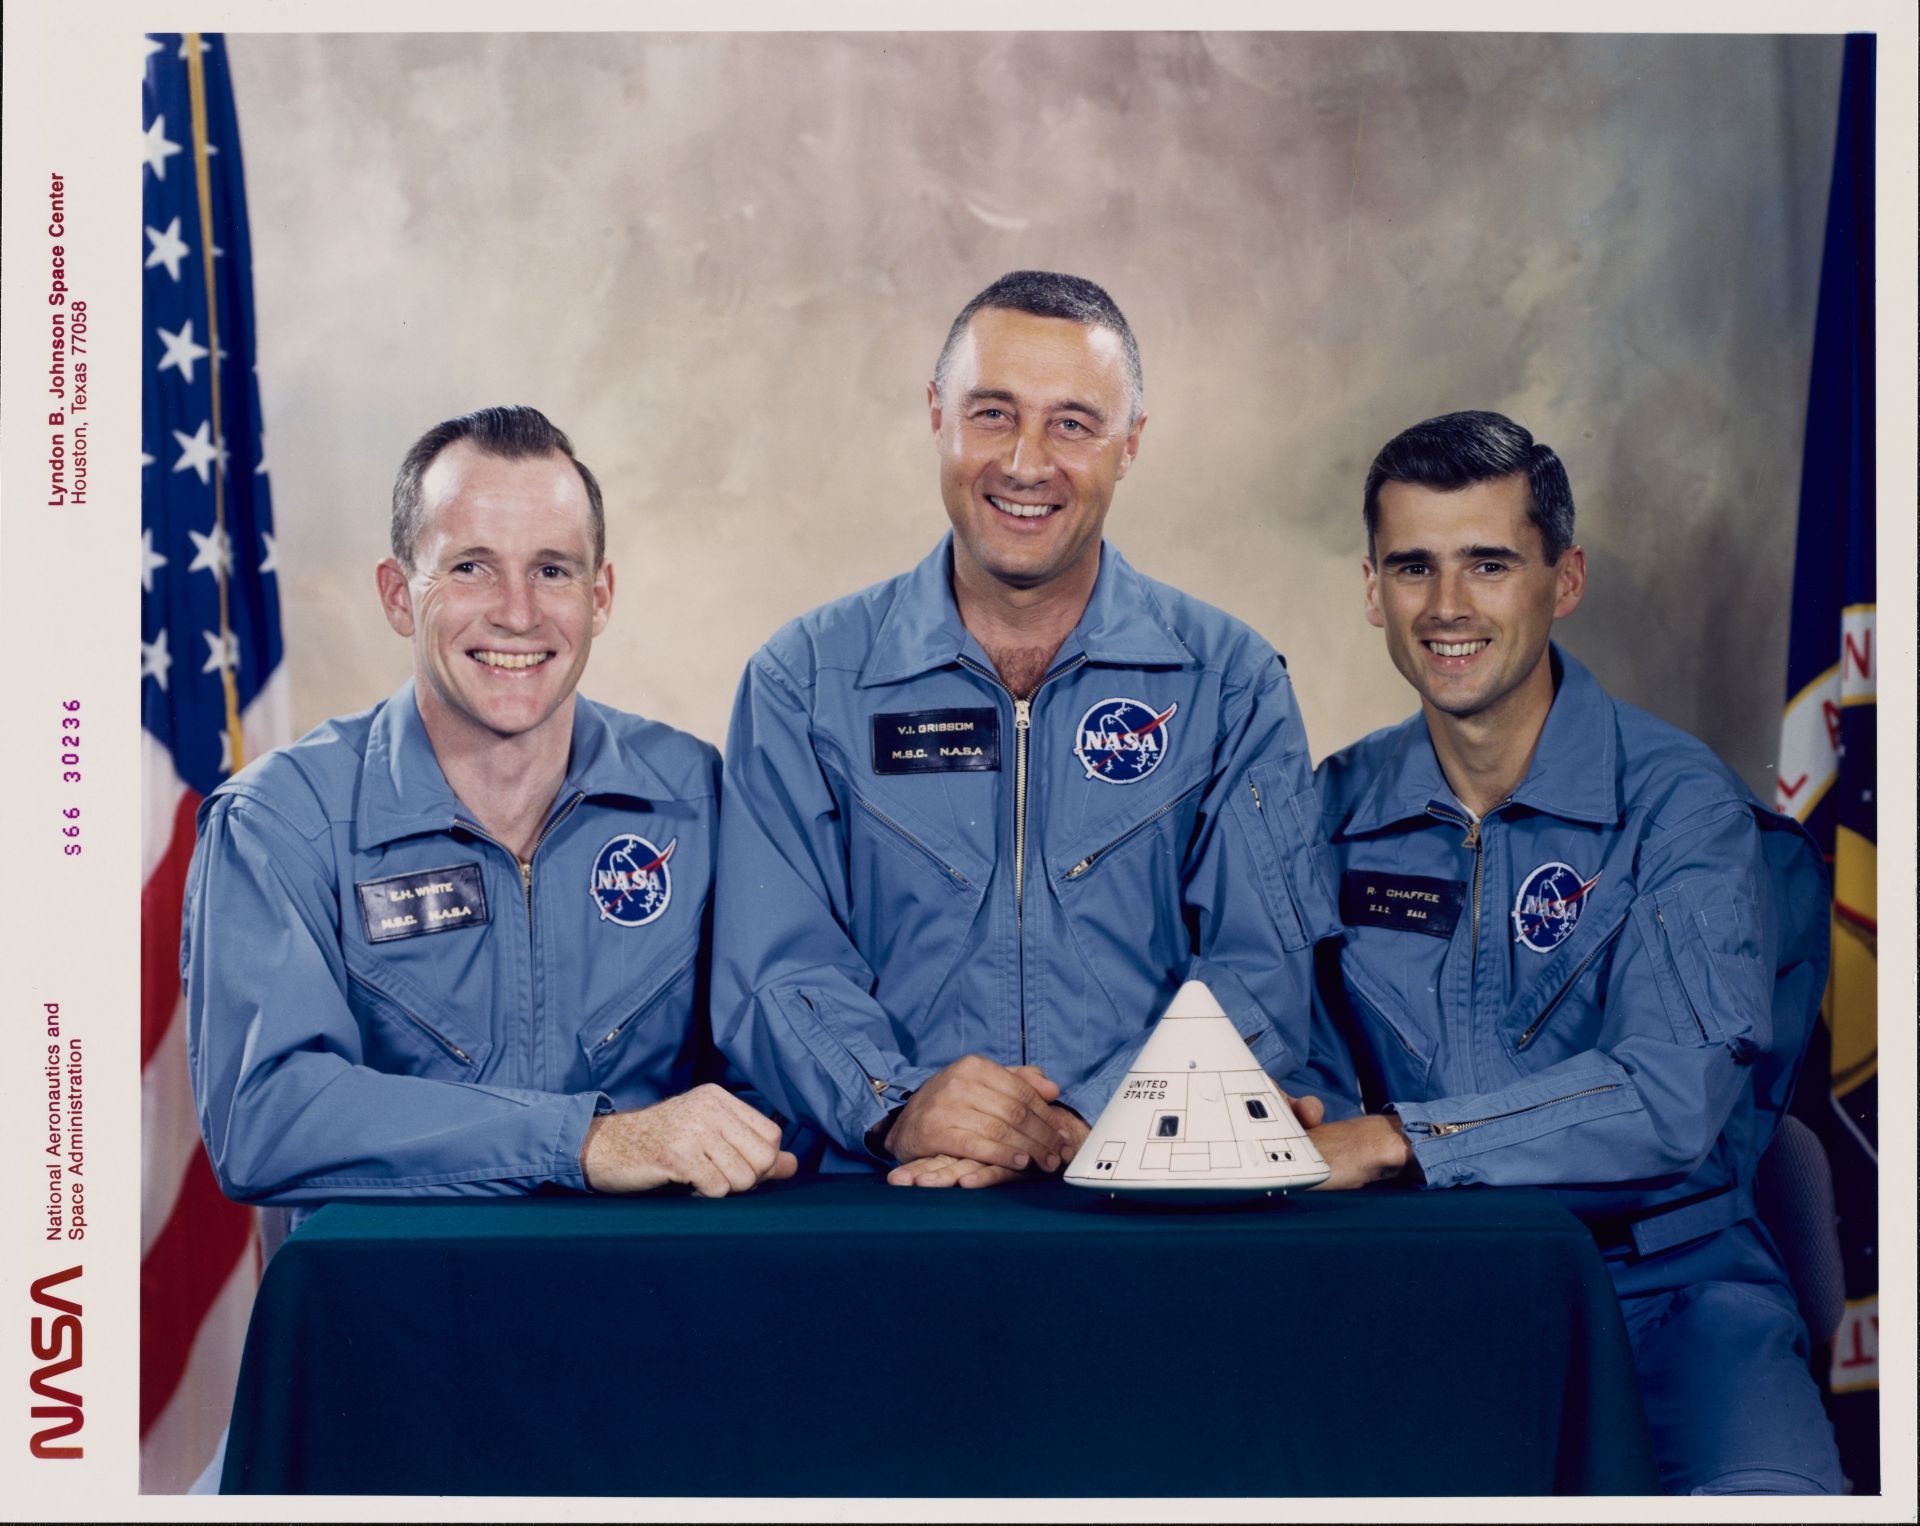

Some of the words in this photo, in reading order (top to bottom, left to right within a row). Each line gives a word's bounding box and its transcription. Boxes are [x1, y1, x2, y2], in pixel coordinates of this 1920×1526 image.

[917, 721, 975, 735] GRISSOM
[1084, 729, 1159, 752] NASA
[891, 748, 929, 760] M.S.C.
[597, 869, 663, 892] NASA
[415, 881, 454, 897] WHITE
[1385, 888, 1441, 904] CHAFFEE
[1523, 894, 1579, 921] NASA
[1129, 1079, 1168, 1089] UNITED
[1123, 1090, 1166, 1100] STATES
